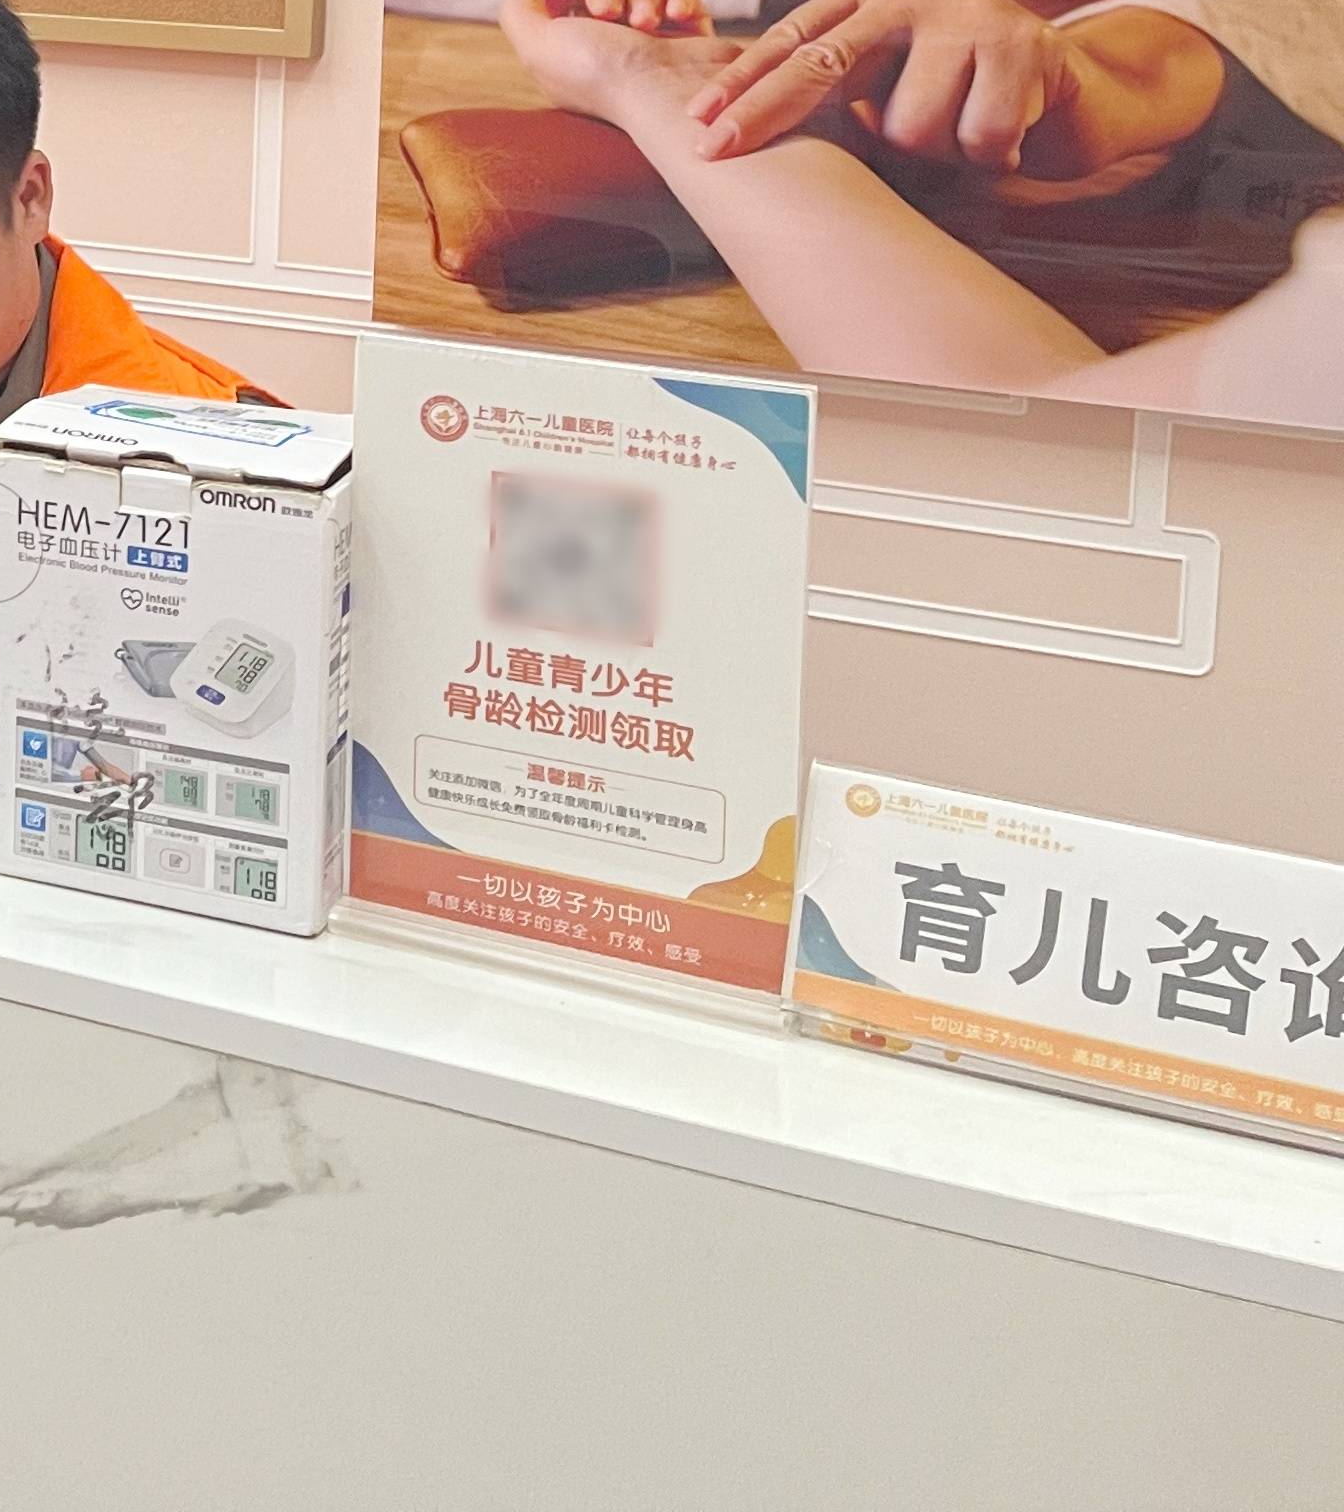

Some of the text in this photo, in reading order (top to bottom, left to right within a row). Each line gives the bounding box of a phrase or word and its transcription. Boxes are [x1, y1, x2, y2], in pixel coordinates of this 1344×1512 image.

[473, 405, 614, 436] 上海六一儿童医院
[626, 427, 702, 449] 让每个孩子
[625, 445, 737, 471] 都拥有健康身心
[199, 488, 276, 514] OMRON
[17, 497, 190, 550] HEM-7121
[17, 530, 184, 570] 电子血压计 上臂式
[18, 551, 188, 587] Electronic Blood Pressure Monitor
[145, 604, 180, 617] sense
[464, 639, 675, 707] 儿童青少年
[443, 682, 696, 762] 骨龄检测领取
[527, 762, 606, 794] 温馨提示
[457, 872, 671, 934] 一切以孩子为中心
[426, 890, 703, 967] 高度关注孩子的安全、疗效、感受
